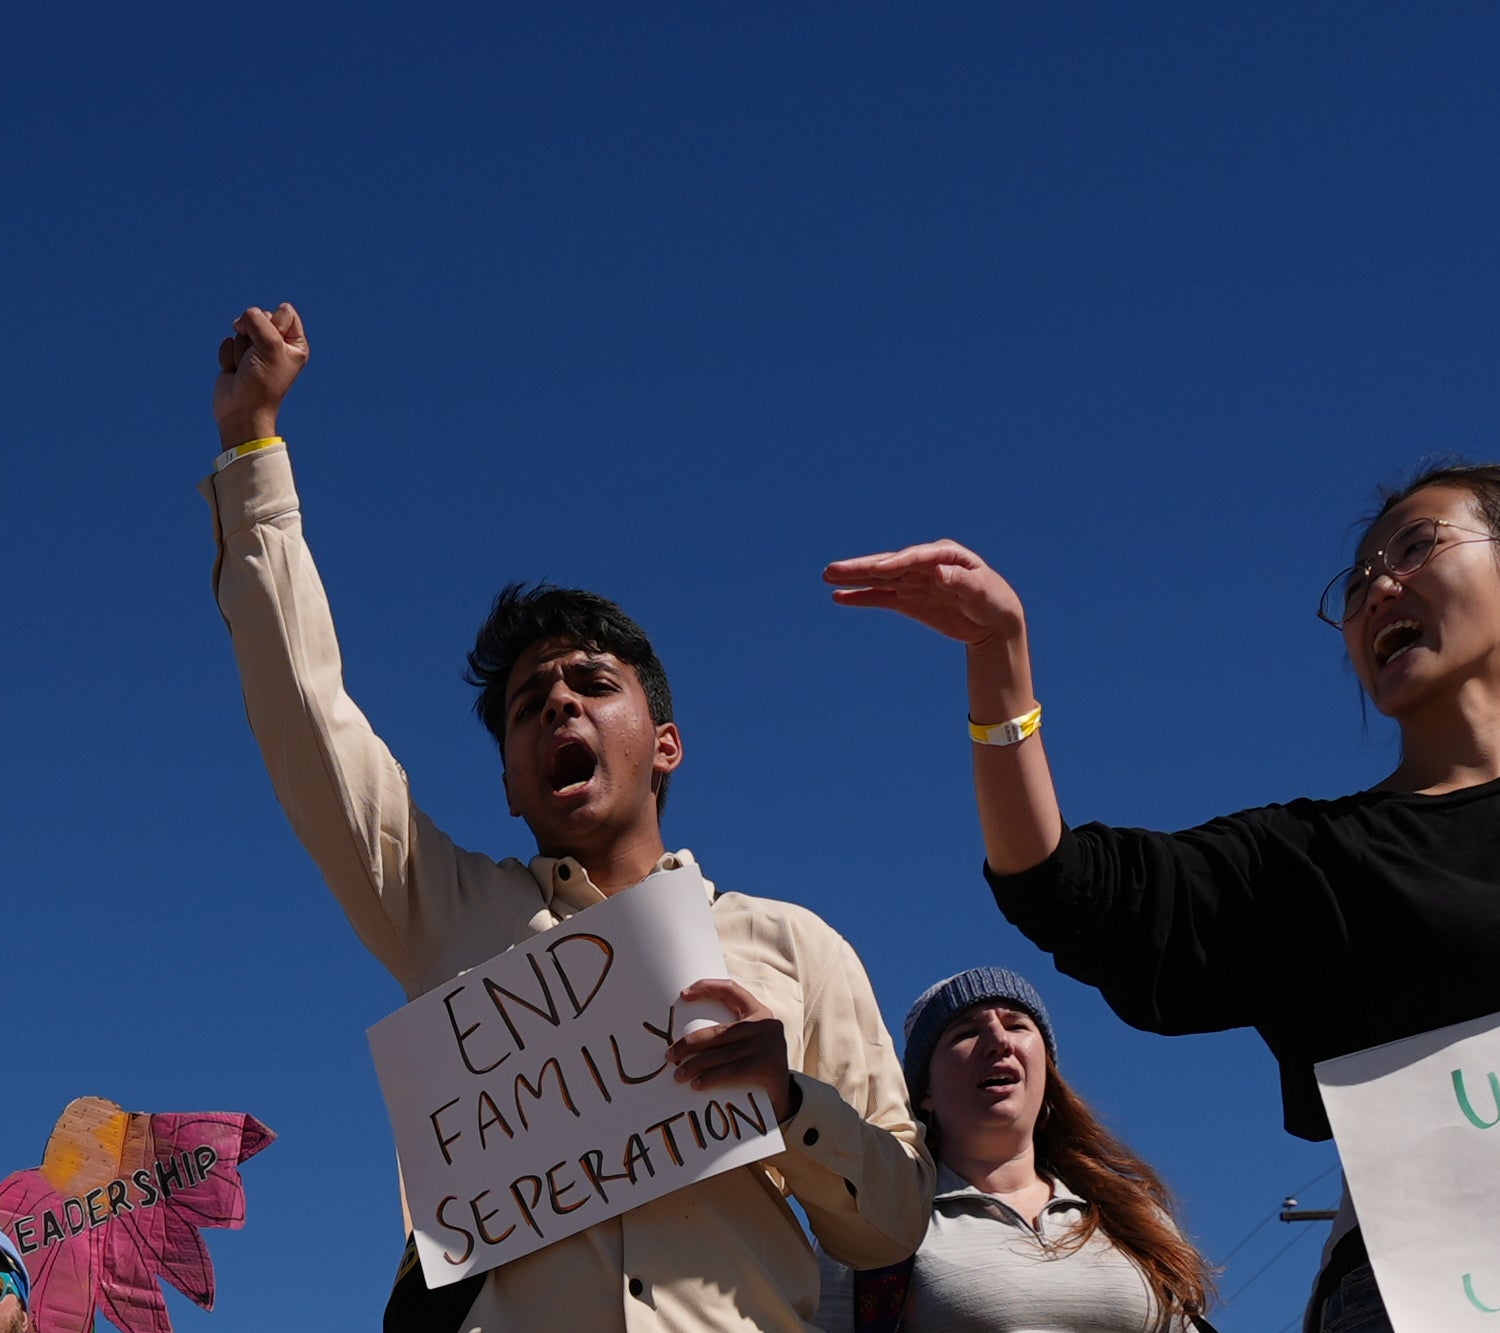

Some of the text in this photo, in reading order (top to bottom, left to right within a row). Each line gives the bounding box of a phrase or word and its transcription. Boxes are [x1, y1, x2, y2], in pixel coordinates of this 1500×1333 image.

[443, 932, 614, 1075] END
[430, 1005, 677, 1166] FAMILY
[14, 1144, 219, 1258] EADERSHIP
[435, 1092, 768, 1265] SEPERATION
